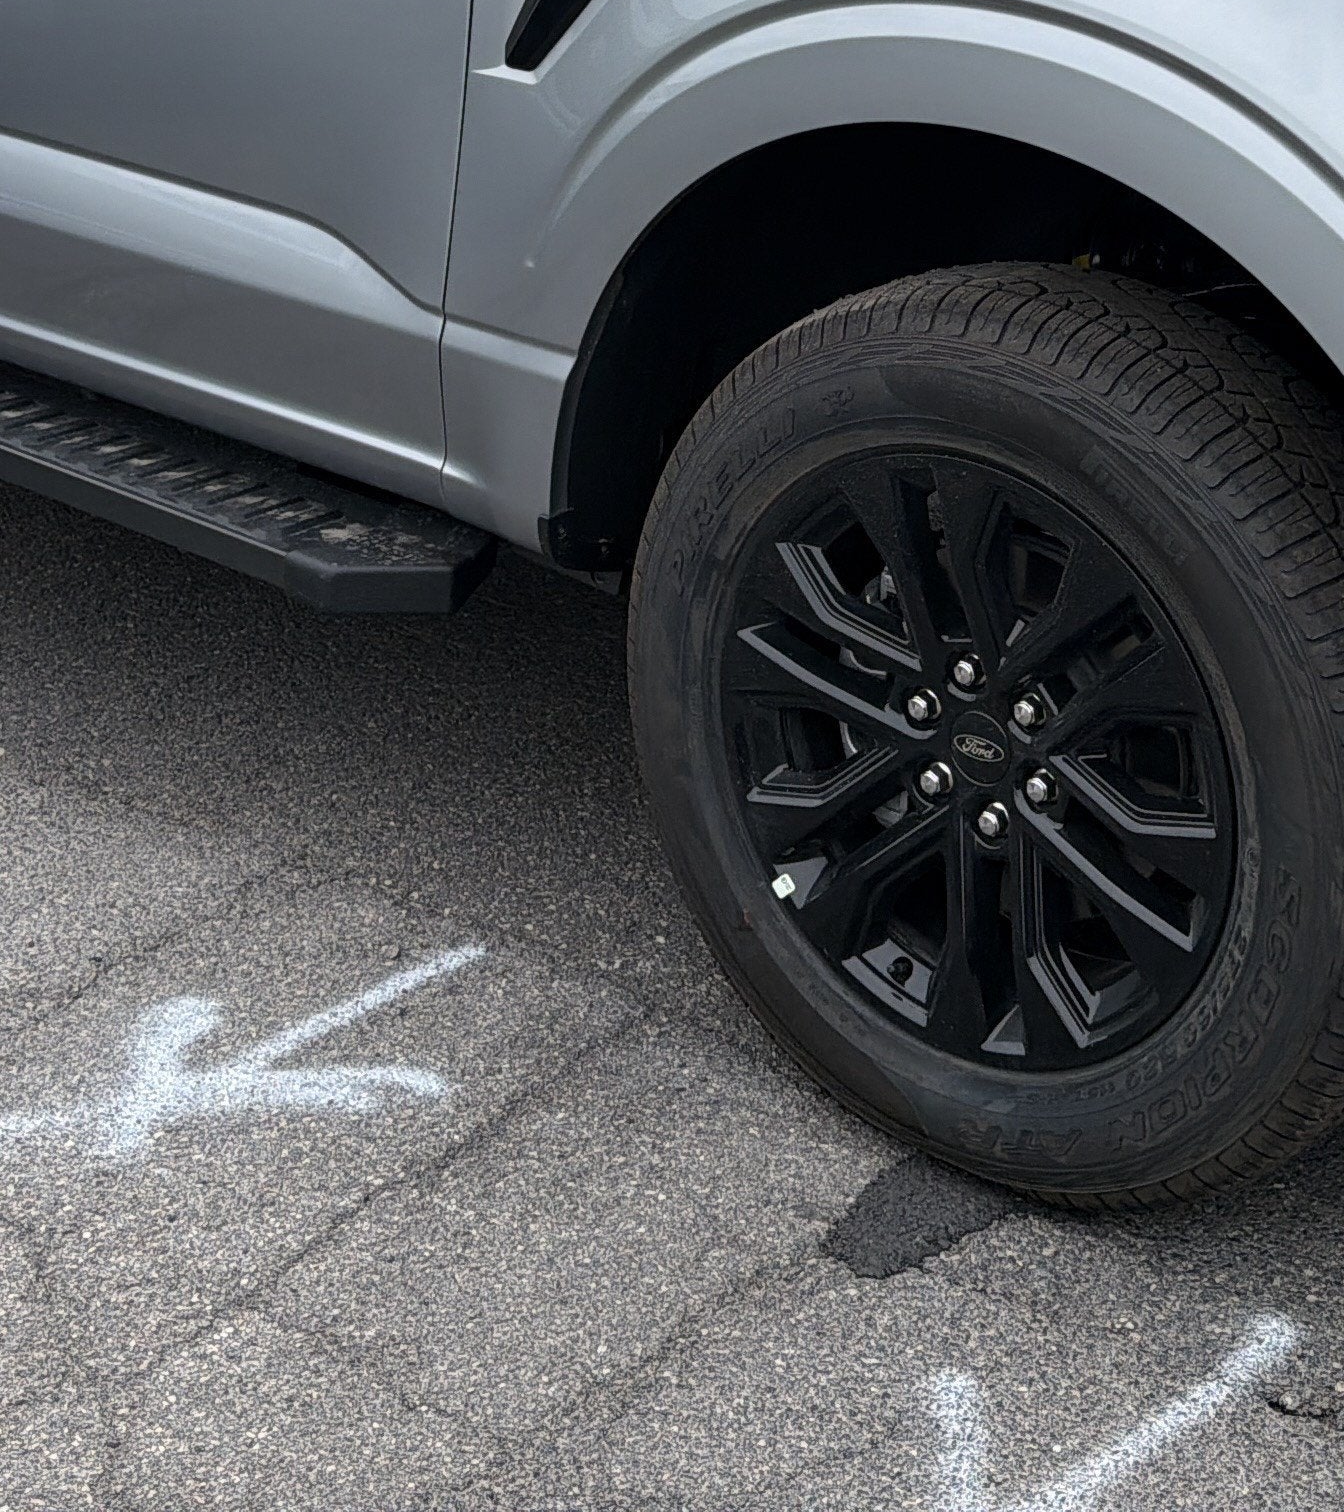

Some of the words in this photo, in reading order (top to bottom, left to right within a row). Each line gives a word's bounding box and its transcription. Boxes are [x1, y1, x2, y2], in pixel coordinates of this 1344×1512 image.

[666, 407, 797, 598] PIRELLI
[962, 738, 996, 759] Ford
[1107, 864, 1303, 1156] SCORPION
